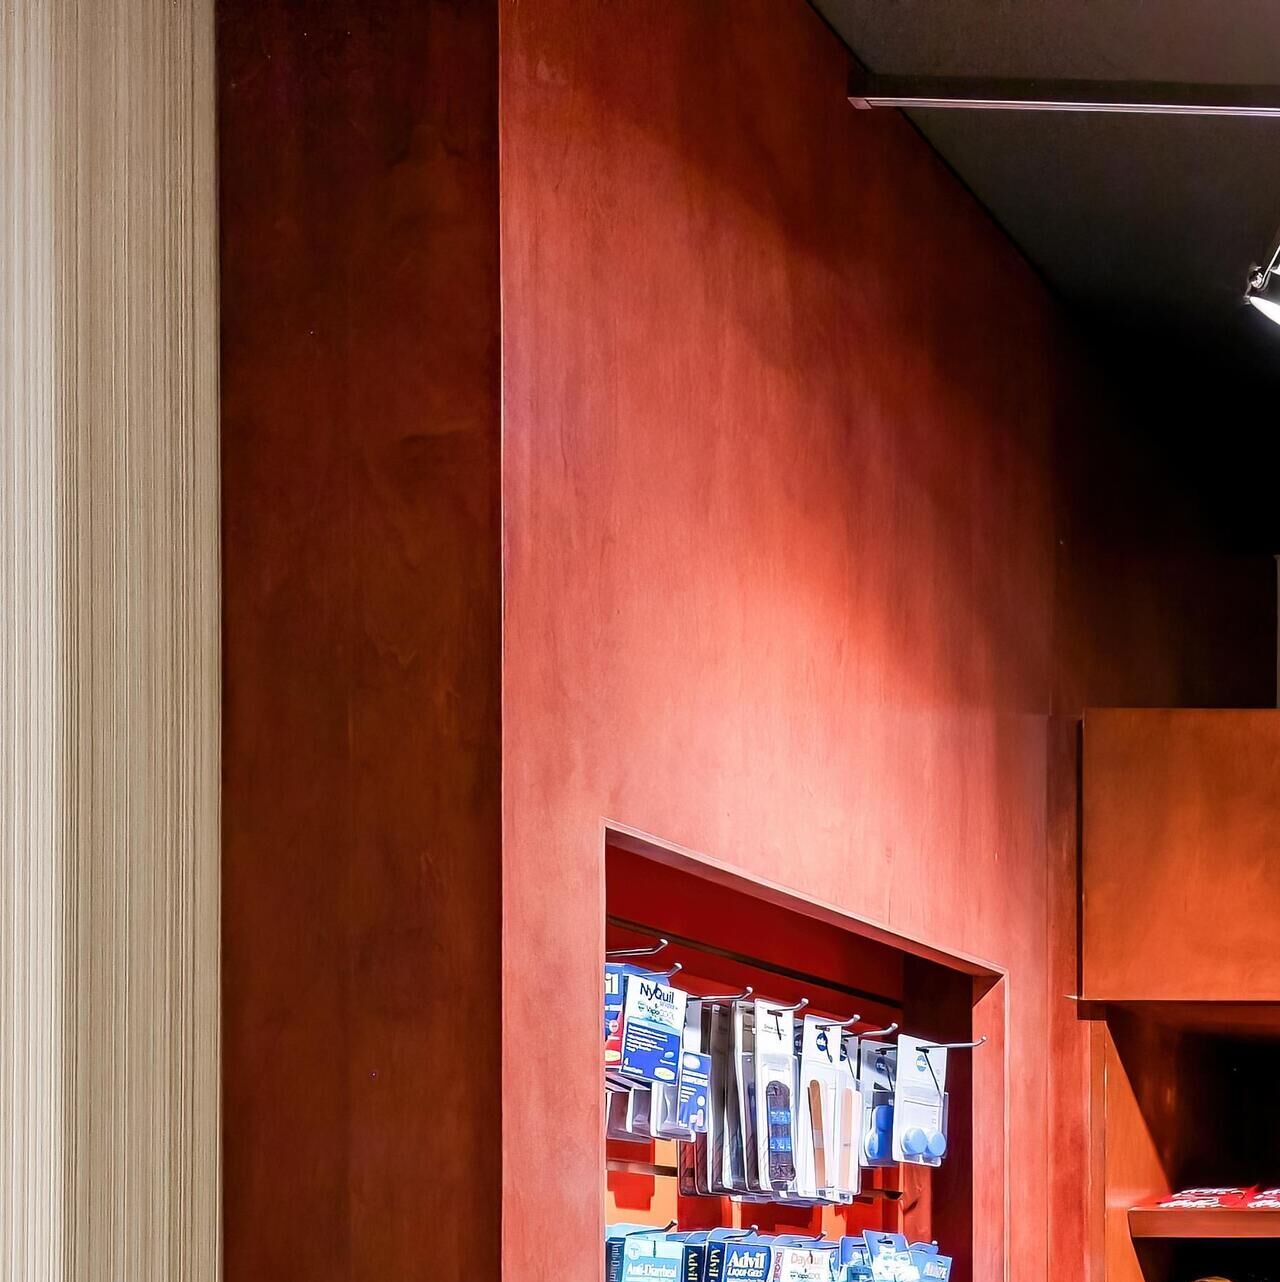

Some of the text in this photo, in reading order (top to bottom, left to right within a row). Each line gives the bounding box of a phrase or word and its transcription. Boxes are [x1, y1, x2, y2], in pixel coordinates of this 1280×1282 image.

[640, 982, 675, 1004] NyQuil
[688, 1249, 698, 1281] Advil
[708, 1245, 721, 1277] Advil
[727, 1250, 767, 1269] Advil
